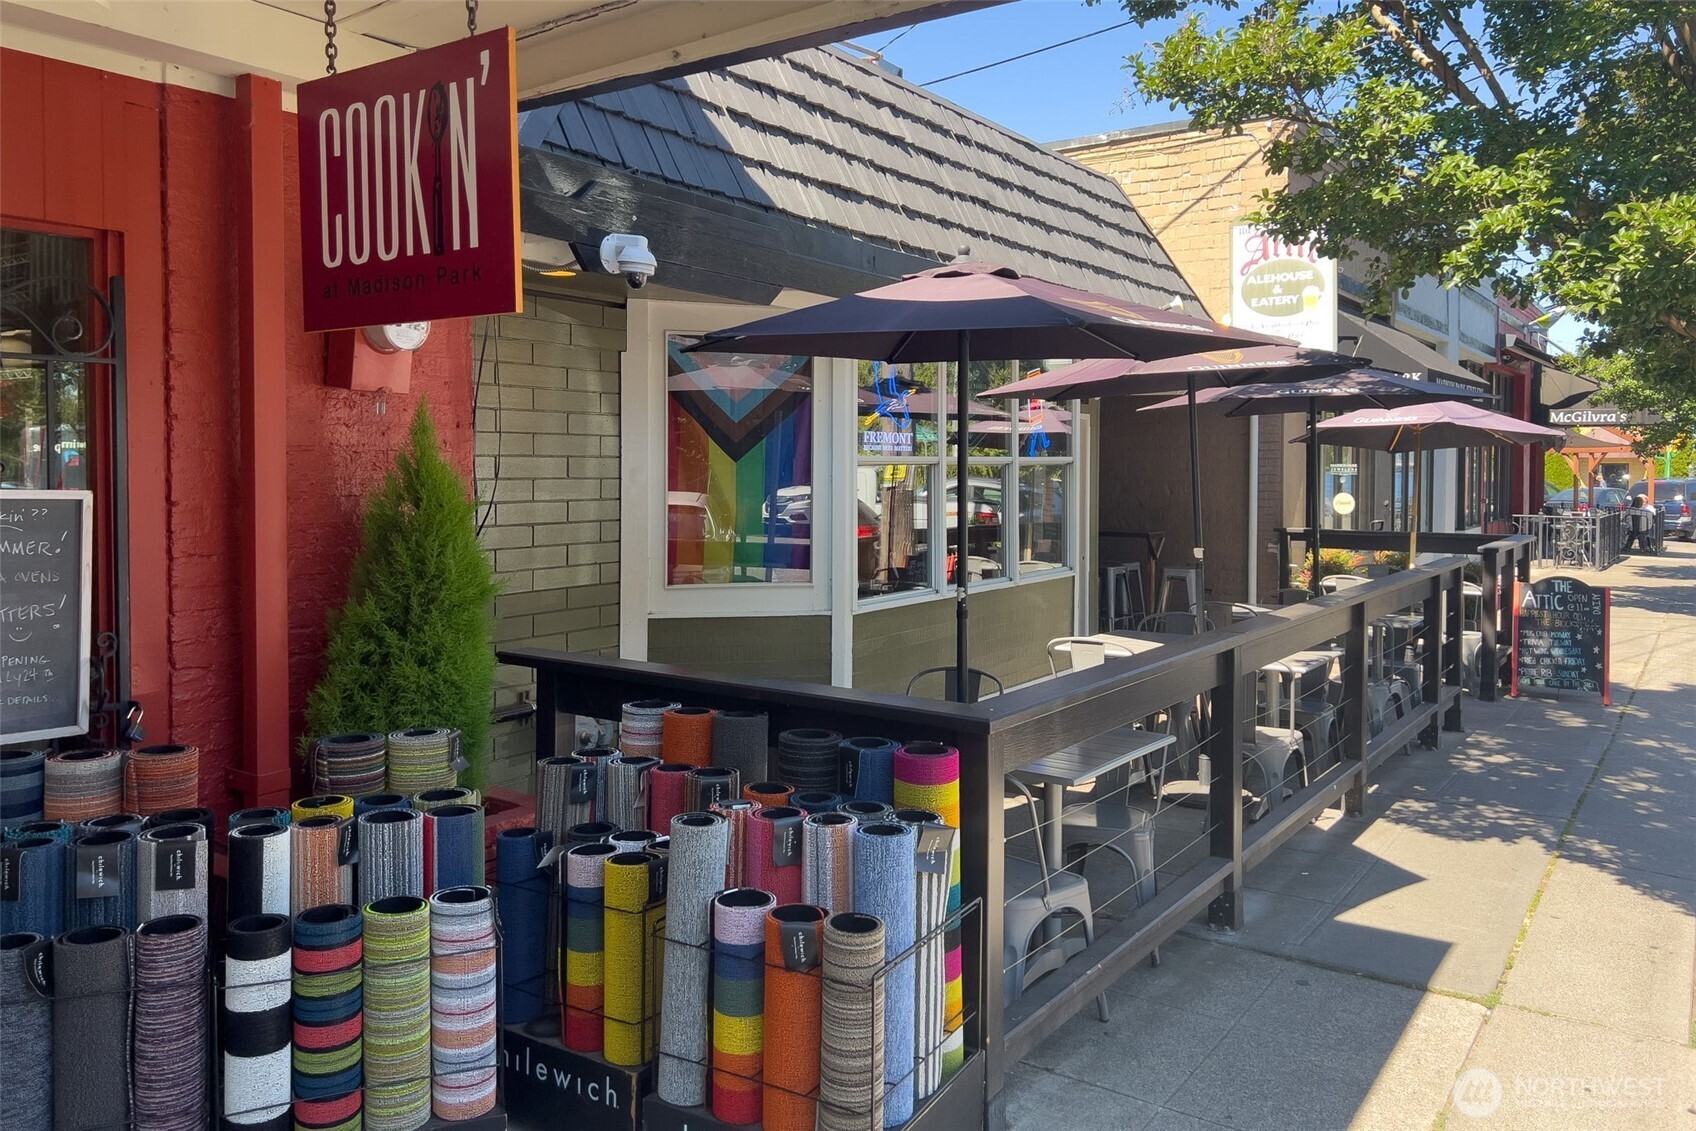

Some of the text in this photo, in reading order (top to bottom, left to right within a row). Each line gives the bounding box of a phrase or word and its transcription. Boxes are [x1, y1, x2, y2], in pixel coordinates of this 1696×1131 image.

[323, 264, 482, 299] at Madison Park
[1246, 270, 1315, 285] ALEHOUSE
[1272, 285, 1283, 294] &
[1250, 294, 1301, 308] EATERY
[1549, 411, 1628, 423] McGilvra's
[863, 431, 914, 445] FREMONT
[14, 571, 60, 583] OVENS
[1551, 580, 1573, 594] THE
[798, 931, 807, 963] chilewich
[504, 1047, 618, 1108] ilewich
